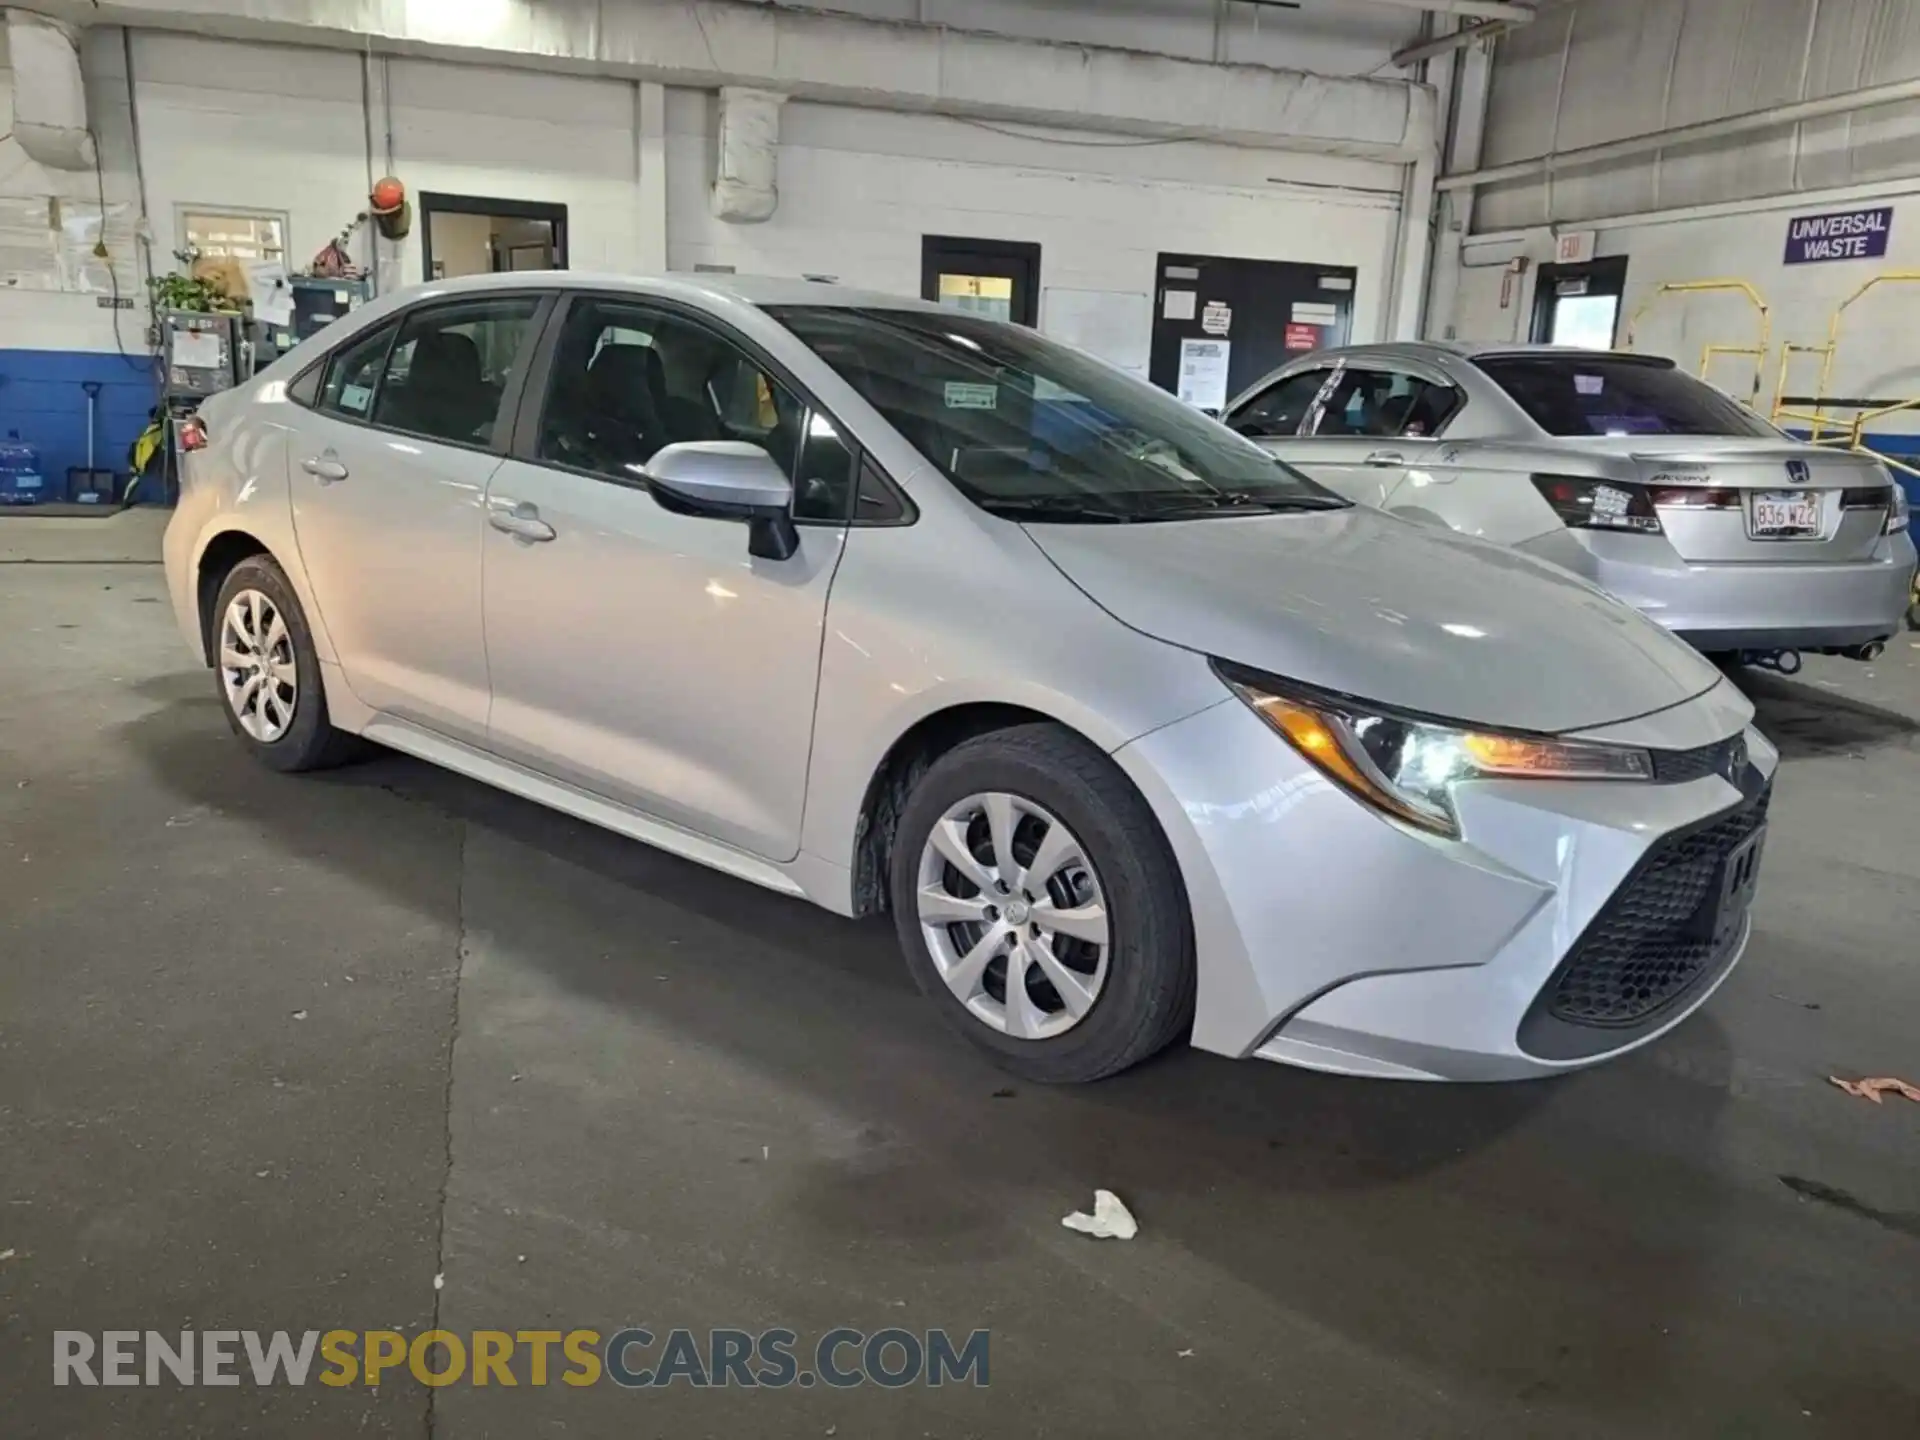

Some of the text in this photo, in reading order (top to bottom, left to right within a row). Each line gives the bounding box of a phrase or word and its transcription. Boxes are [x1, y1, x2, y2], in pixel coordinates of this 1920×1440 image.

[1792, 211, 1886, 240] UNIVERSAL
[1804, 236, 1868, 259] WASTE
[1758, 503, 1785, 525] 836
